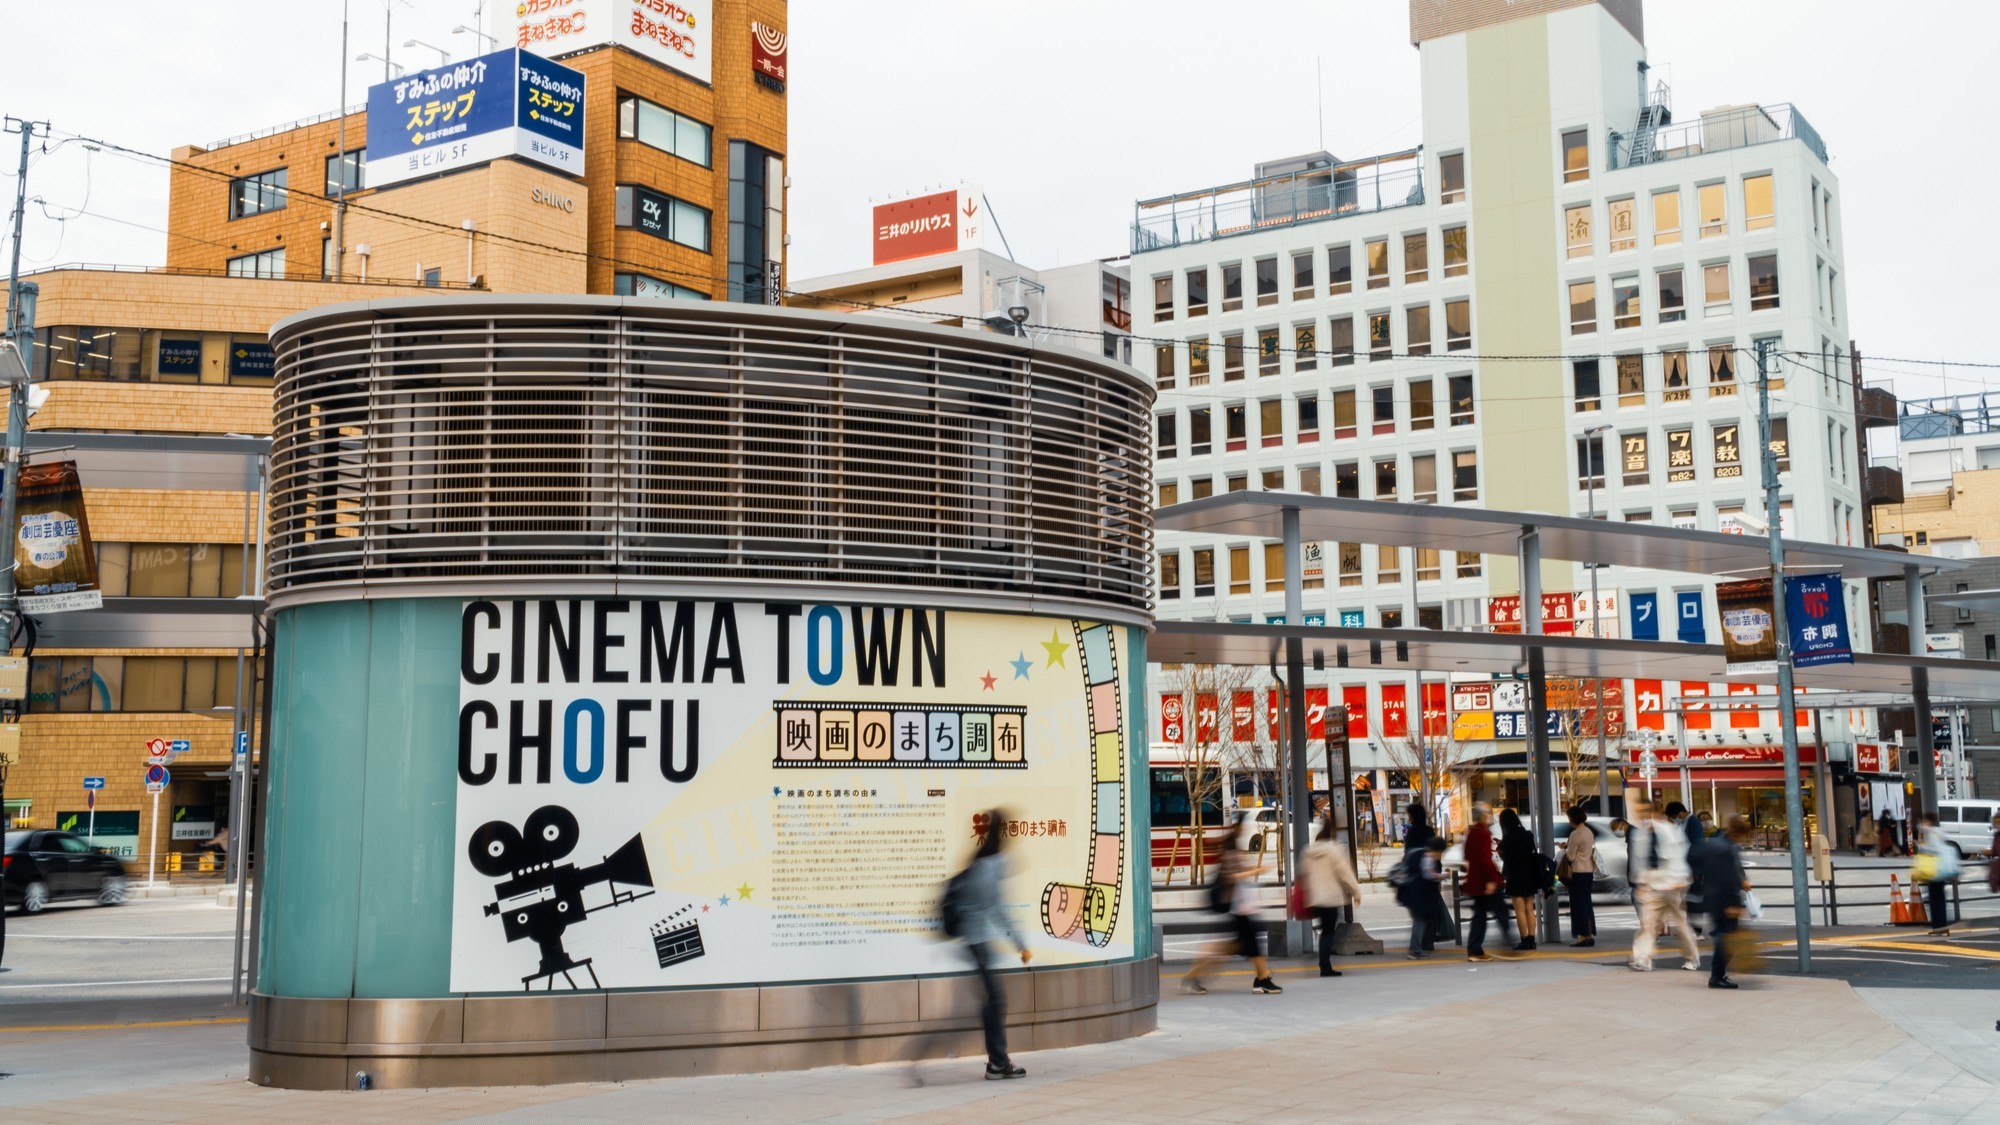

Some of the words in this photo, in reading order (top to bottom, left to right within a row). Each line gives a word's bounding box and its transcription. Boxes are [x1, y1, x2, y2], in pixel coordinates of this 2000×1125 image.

[515, 12, 586, 48] まねきねこ
[631, 9, 696, 60] まねきねこ
[757, 58, 785, 79] 一期一会
[394, 60, 488, 105] すみふの仲介
[520, 66, 582, 103] すみふの仲介
[406, 89, 476, 131] ステップ
[528, 87, 575, 117] ステップ
[424, 123, 467, 142] 住友不動産販売
[408, 149, 446, 171] 当ビル
[452, 143, 469, 160] 5F
[531, 139, 557, 157] 当ビル
[559, 151, 570, 162] 5F
[532, 187, 574, 213] SHINO
[879, 213, 952, 241] 三井のリハウス
[965, 227, 977, 239] 1F
[165, 356, 195, 364] ステップ
[1715, 385, 1732, 396] カフェ
[34, 550, 65, 562] 春の公演
[1579, 597, 1614, 612] 宴場
[460, 600, 745, 685] CINEMA
[765, 604, 946, 688] TOWN
[1383, 701, 1405, 709] STAR
[458, 698, 699, 787] CHOFU
[786, 718, 1018, 753] 映画のまち調布
[787, 789, 878, 797] 映画のまち調布の由来
[176, 829, 211, 837] 三井住友銀行
